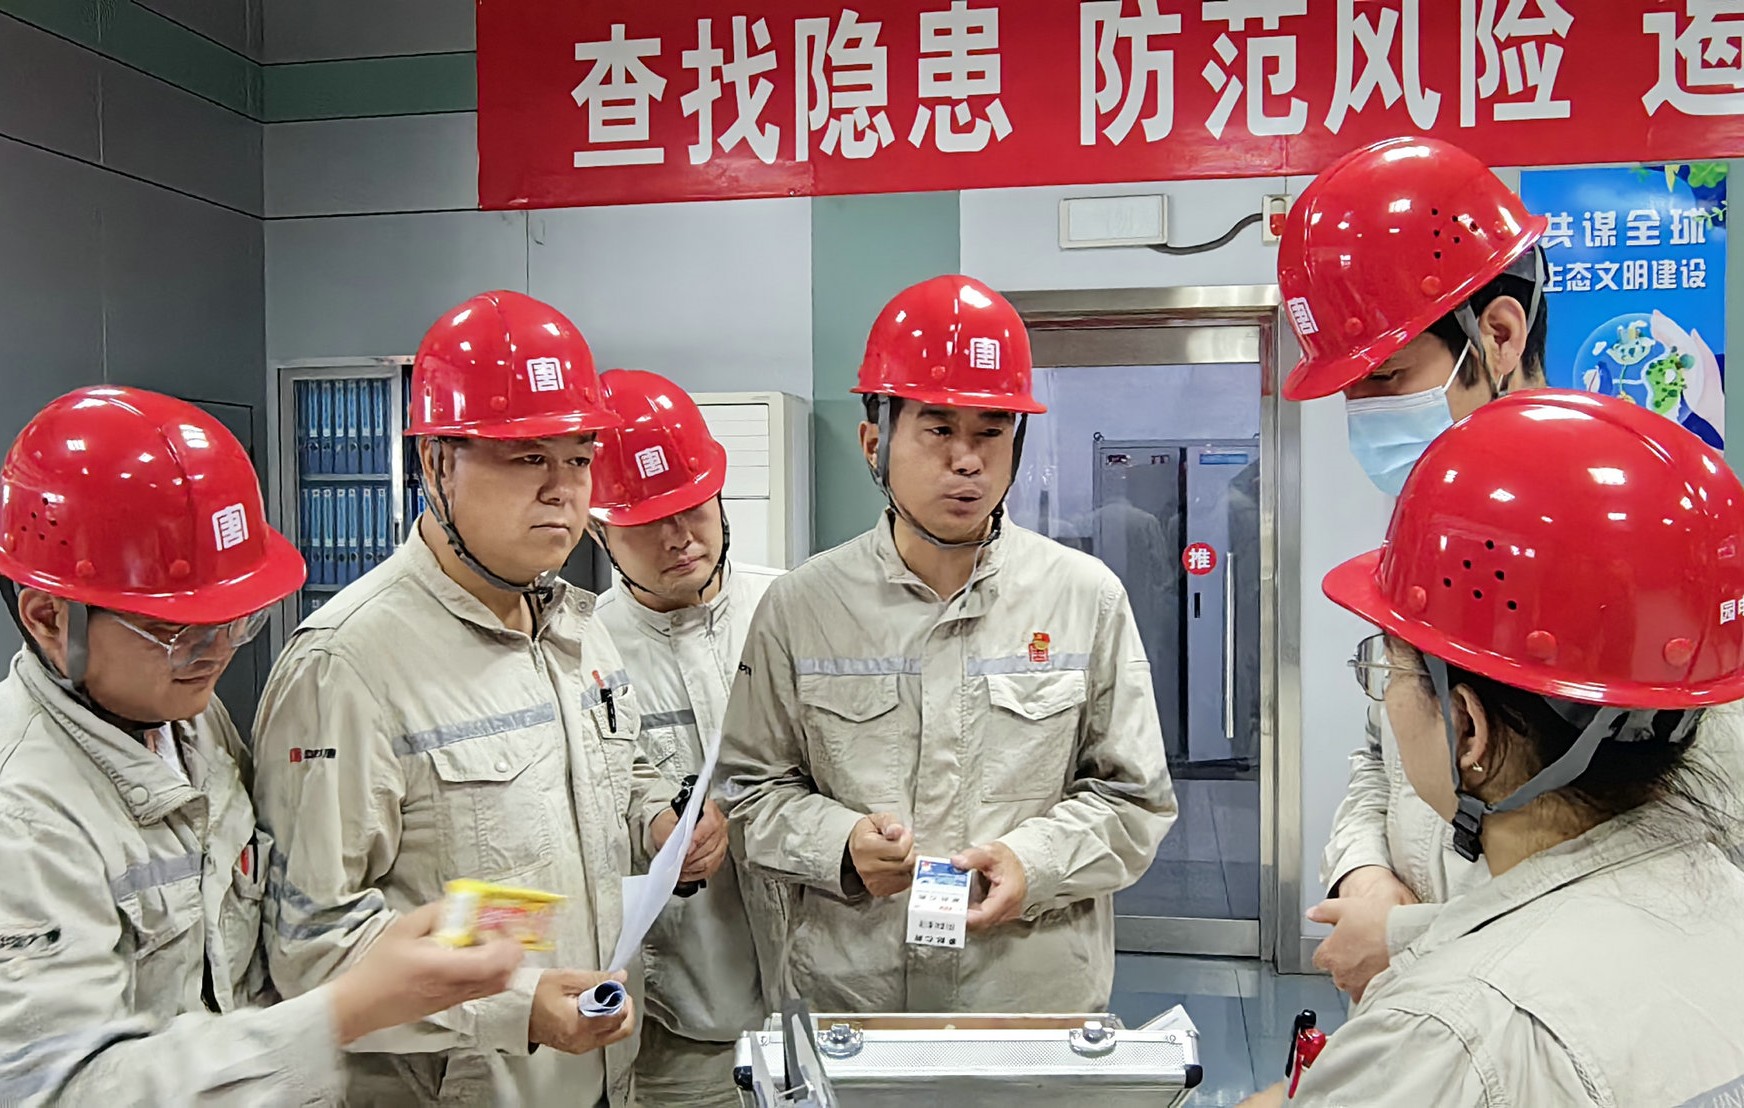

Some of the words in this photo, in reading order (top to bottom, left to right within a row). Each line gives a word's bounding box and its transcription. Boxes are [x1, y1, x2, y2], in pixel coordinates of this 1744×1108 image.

[571, 0, 1013, 168] 查找隐患
[1079, 0, 1575, 147] 防范风险
[1543, 207, 1707, 249] 共谋全球
[1542, 258, 1707, 293] 生态文明建设
[1188, 547, 1211, 570] 推
